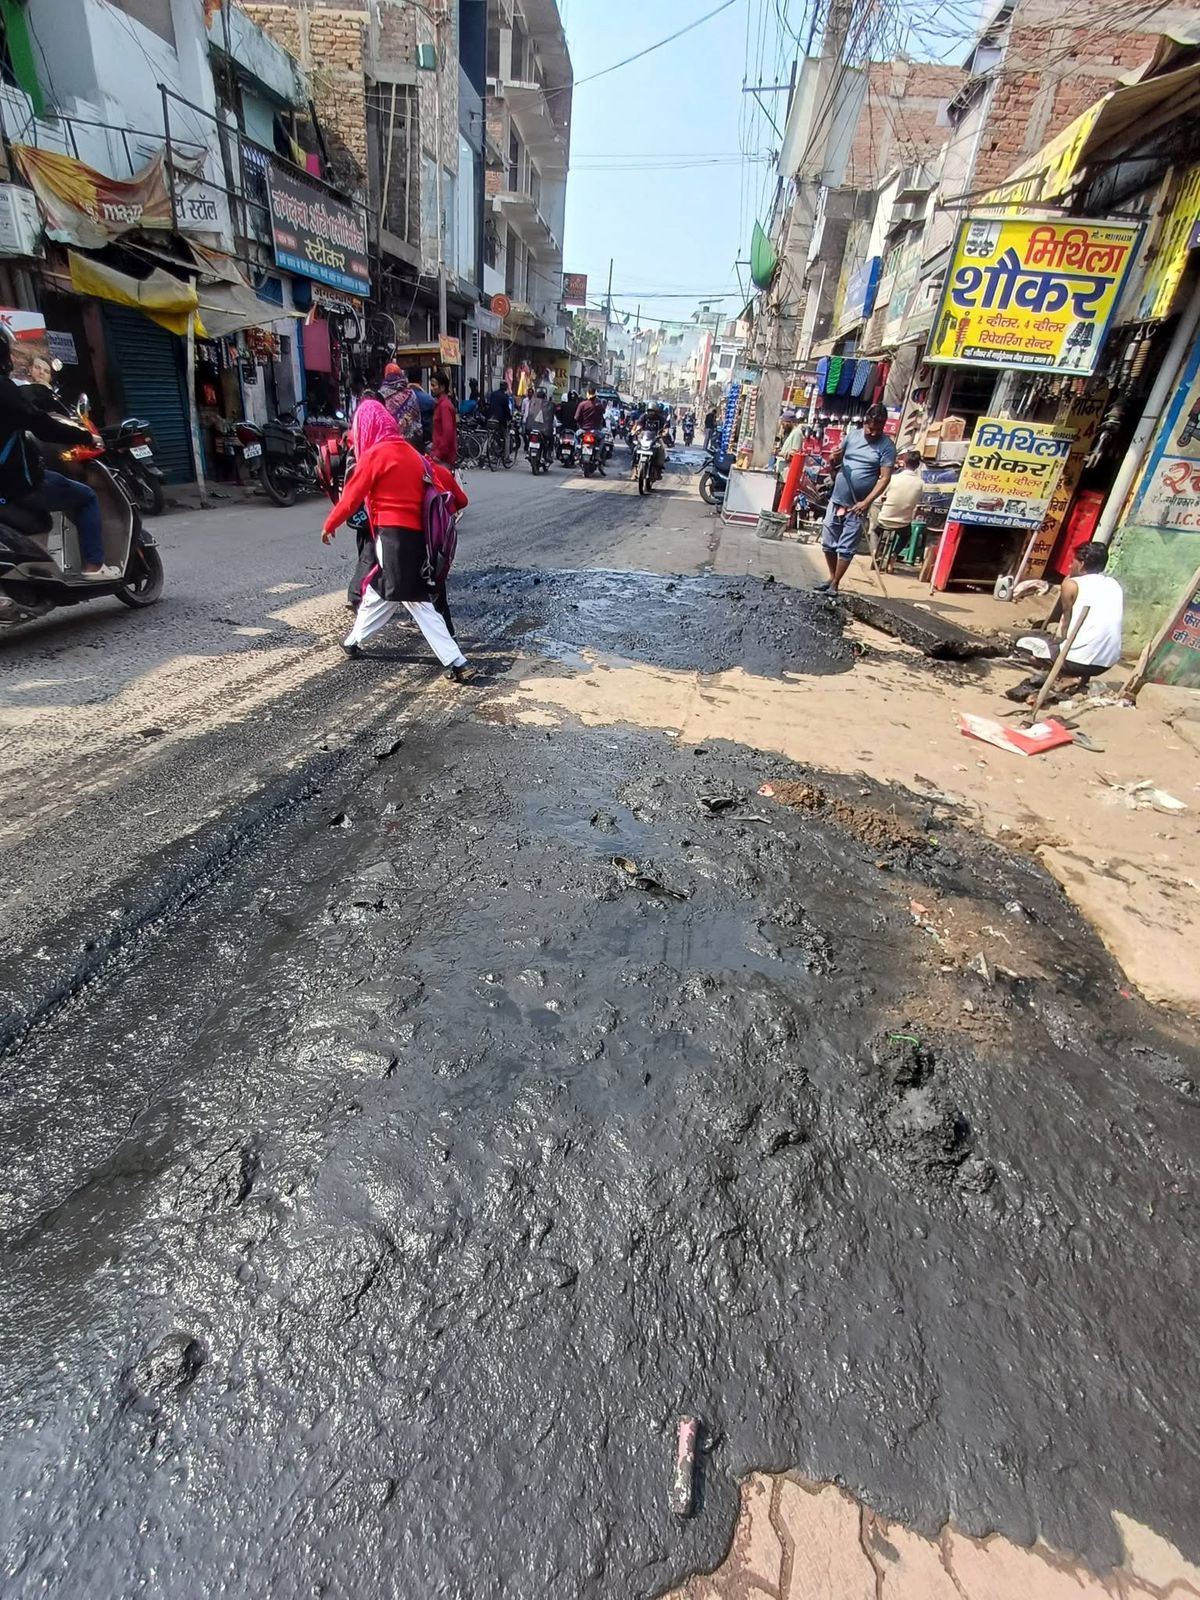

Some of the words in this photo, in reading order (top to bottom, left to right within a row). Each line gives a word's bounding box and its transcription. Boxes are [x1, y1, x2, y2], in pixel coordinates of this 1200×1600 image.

[187, 193, 218, 220] स्टॉल
[304, 237, 346, 272] स्टीकर
[1024, 226, 1128, 273] मिथिला
[952, 247, 1115, 319] शौकर
[1033, 318, 1066, 333] व्हीलर
[1024, 333, 1053, 350] सेन्टर
[975, 424, 1074, 458] मिथिला
[968, 452, 1050, 477] शौकर
